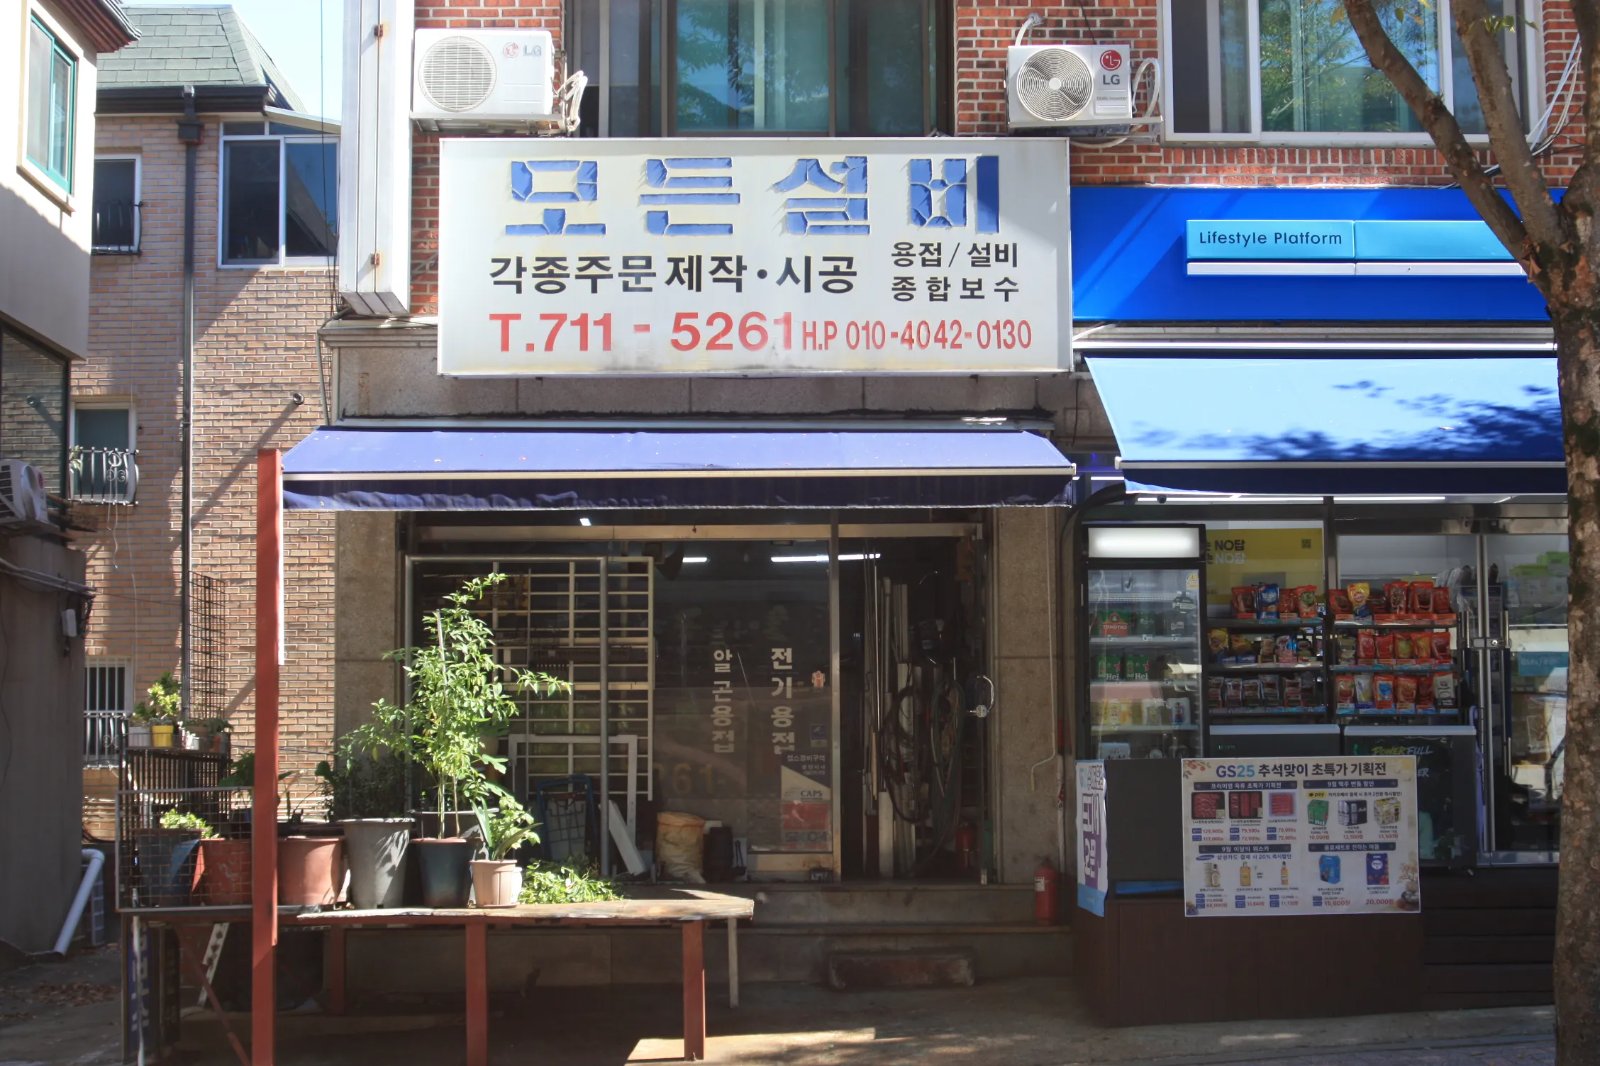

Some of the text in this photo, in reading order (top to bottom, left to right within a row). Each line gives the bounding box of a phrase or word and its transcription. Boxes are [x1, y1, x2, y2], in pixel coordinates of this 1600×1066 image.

[522, 44, 542, 57] LG
[1102, 74, 1121, 86] LG
[505, 155, 1001, 236] 모든설비
[1199, 231, 1342, 248] Lifestyle Platform
[670, 311, 793, 353] 5261
[802, 318, 1033, 351] H.P 010-4042-0130
[710, 649, 734, 753] 알곤용접
[1216, 762, 1387, 778] GS25 추석맞이 초특가 기획전
[801, 789, 823, 798] CAPS
